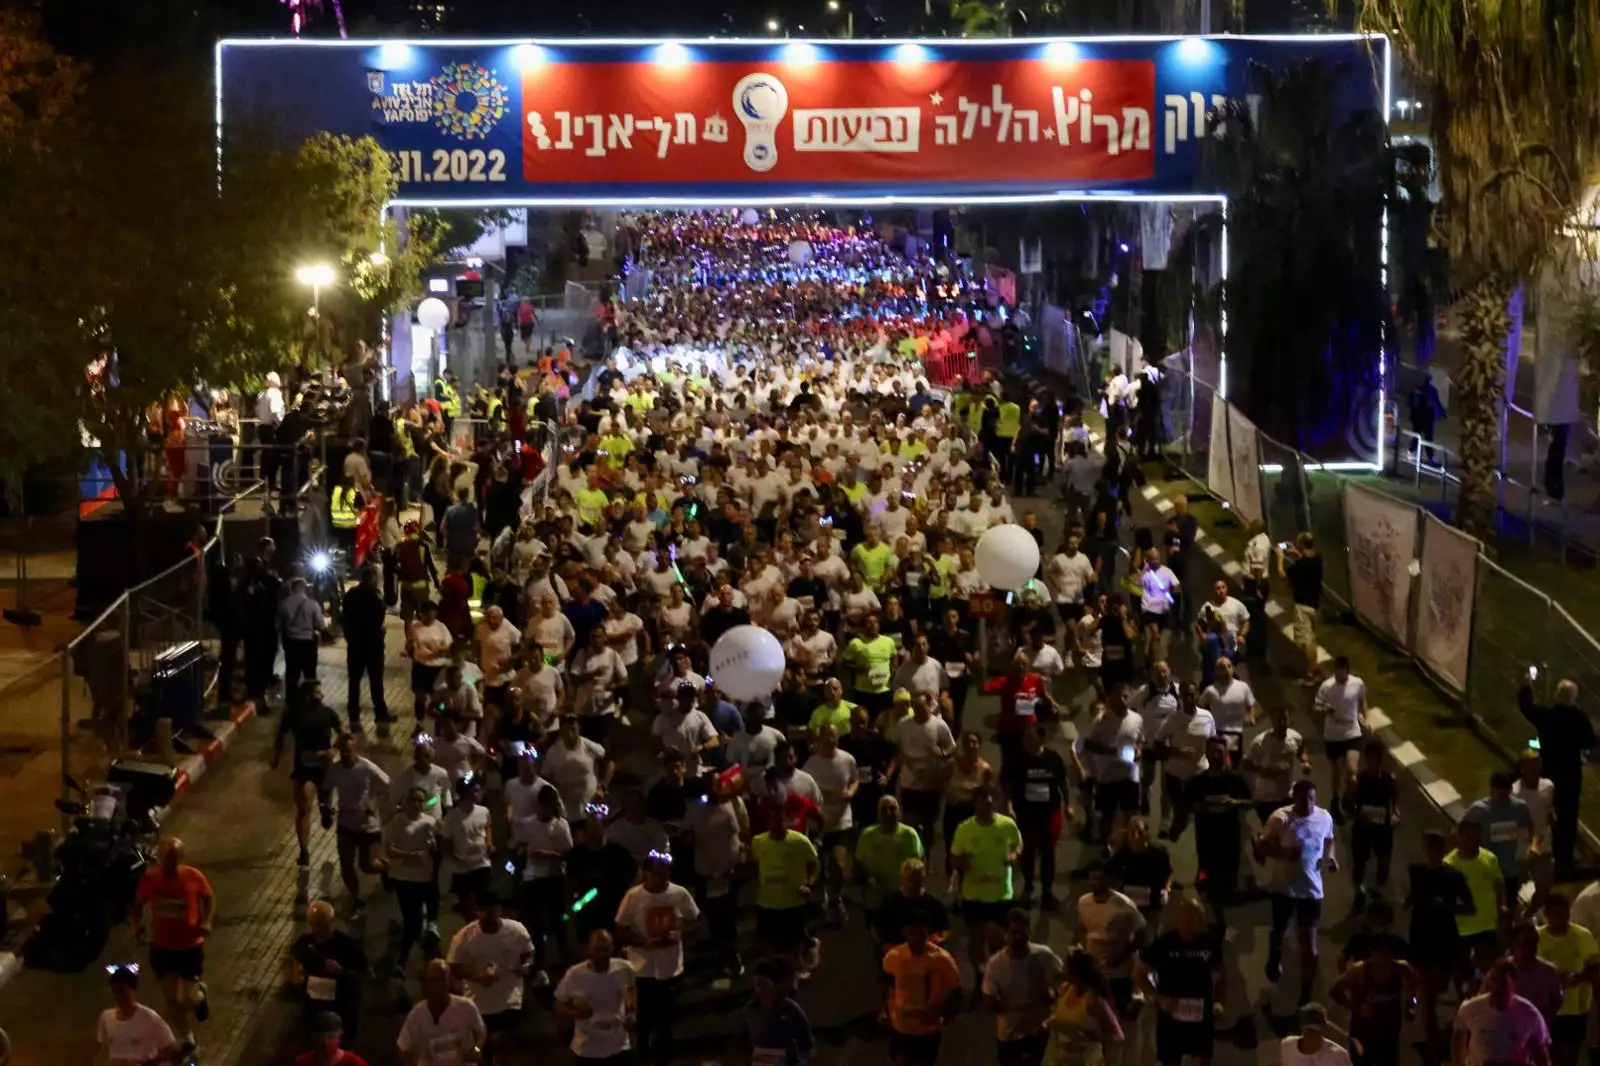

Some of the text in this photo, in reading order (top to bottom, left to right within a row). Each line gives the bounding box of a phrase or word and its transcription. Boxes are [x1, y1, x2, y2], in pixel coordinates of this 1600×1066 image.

[554, 84, 1150, 158] מרוץ הלילה נביעות תל-אביב
